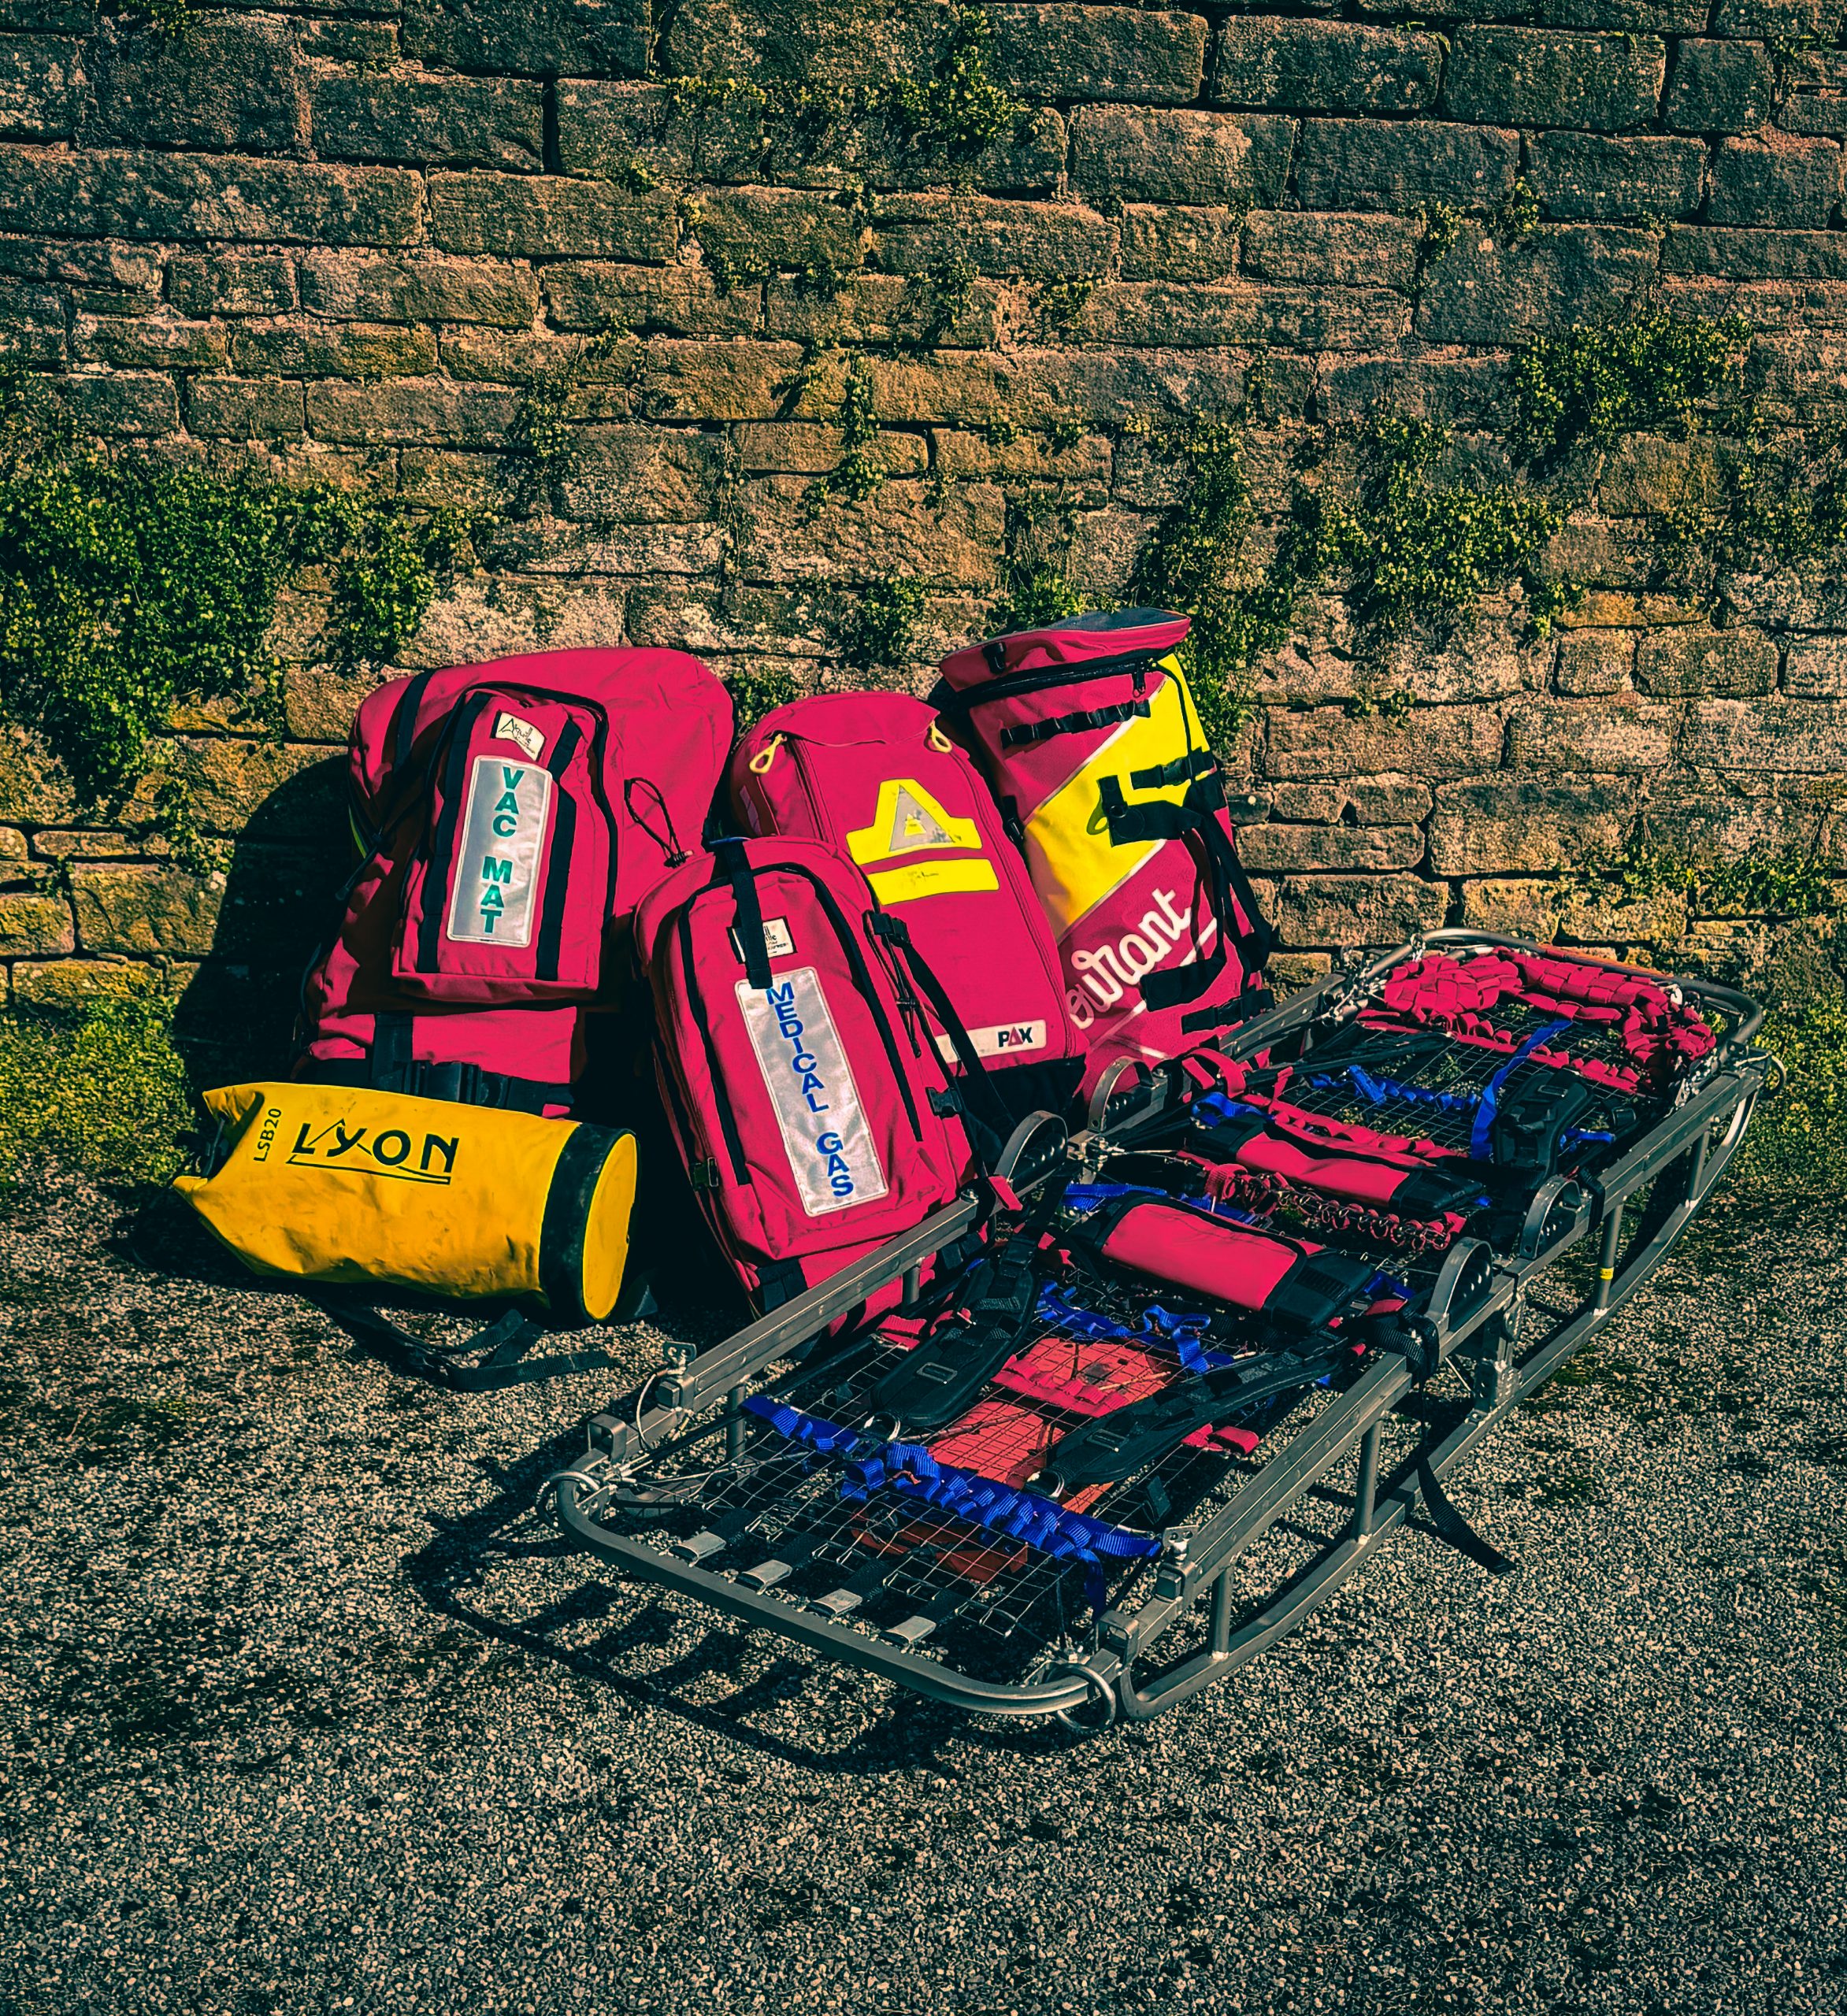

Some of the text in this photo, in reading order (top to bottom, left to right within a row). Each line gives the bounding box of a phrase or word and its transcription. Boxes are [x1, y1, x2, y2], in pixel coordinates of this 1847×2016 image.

[492, 766, 525, 837] VAC
[480, 856, 513, 933] MAT
[1066, 888, 1192, 1029] ourant
[998, 1026, 1033, 1048] PAX
[766, 981, 829, 1113] MEDICAL
[816, 1132, 854, 1197] GAS
[253, 1108, 282, 1162] LSB20
[291, 1121, 460, 1173] LYON
